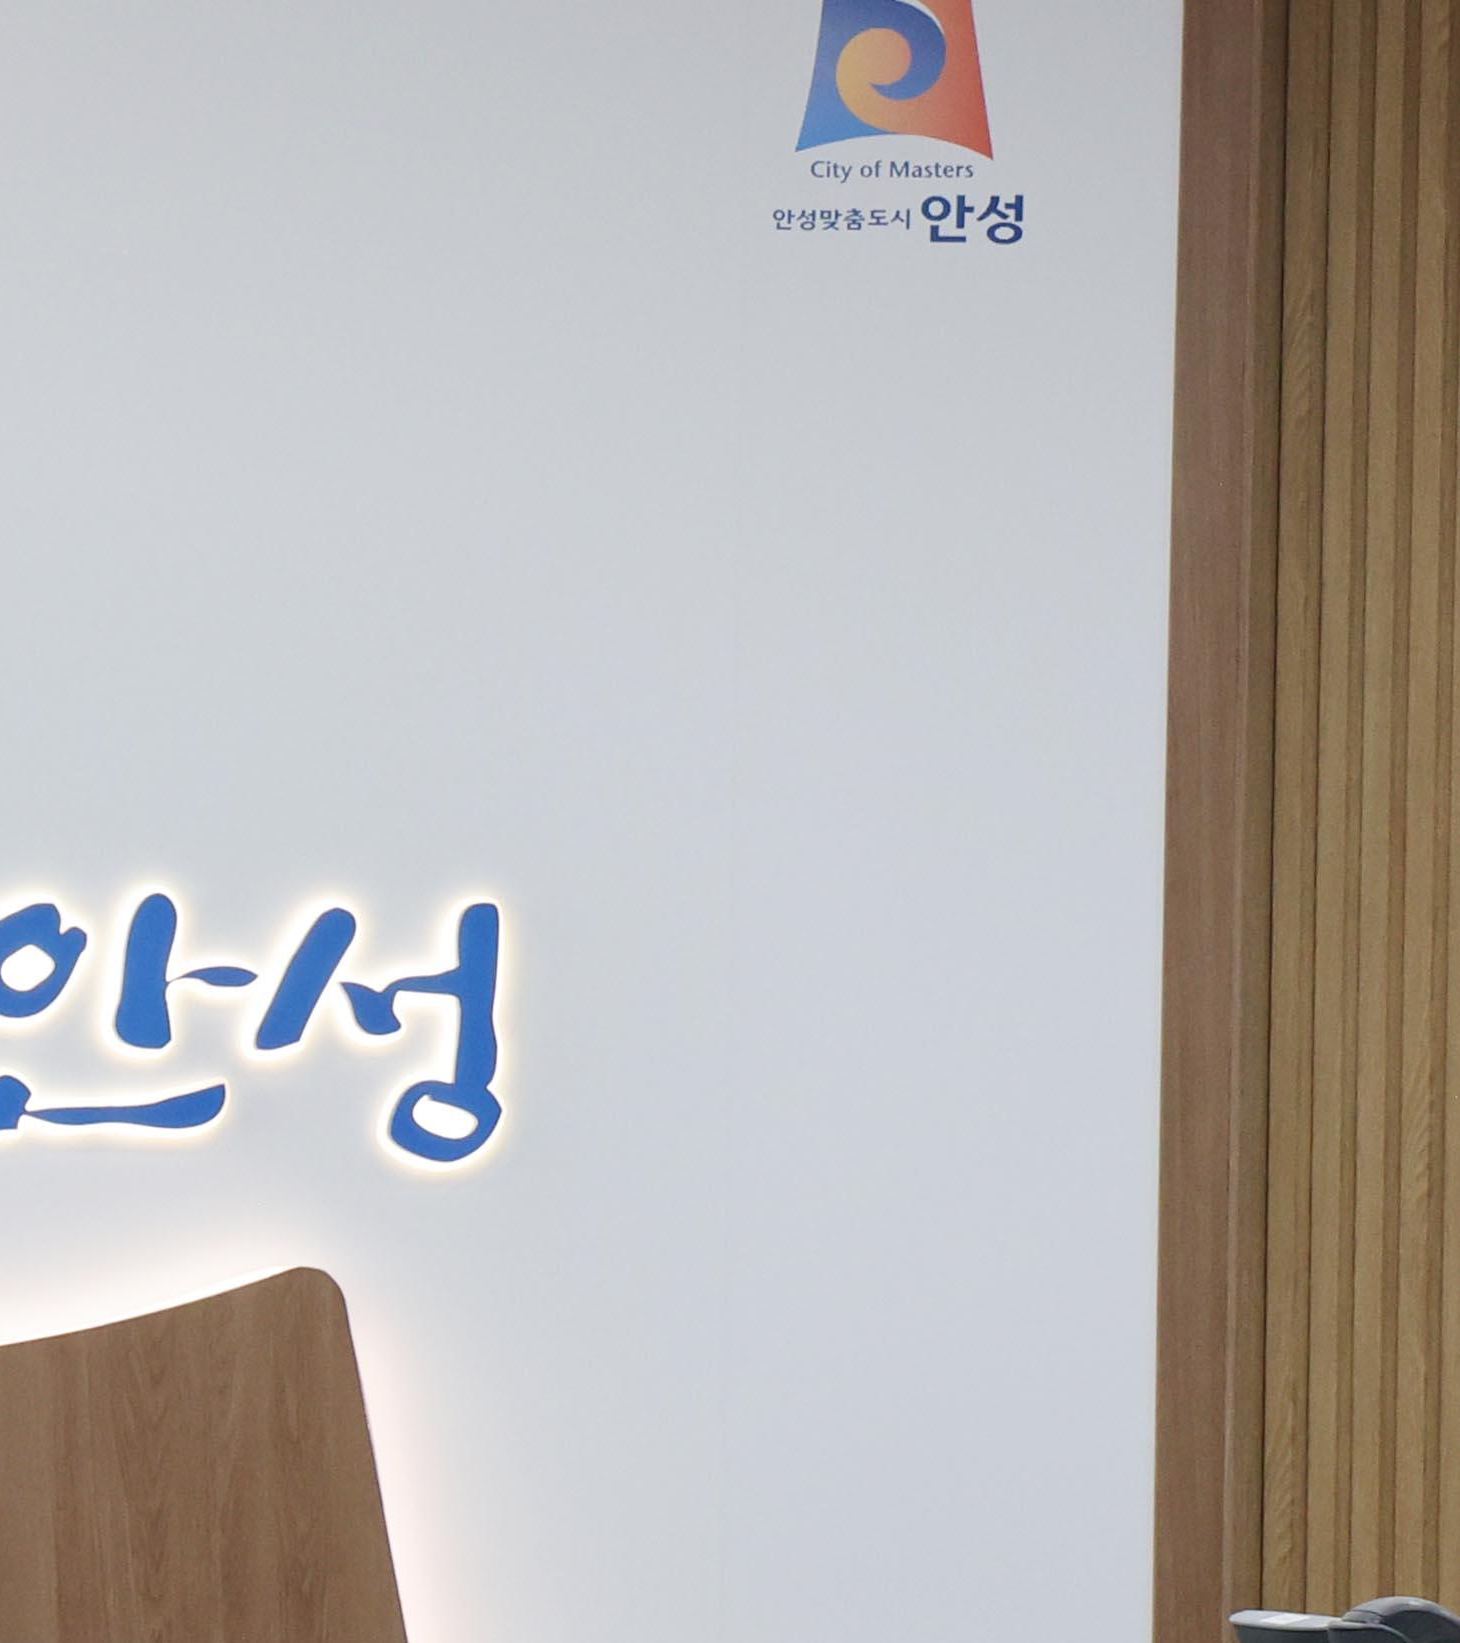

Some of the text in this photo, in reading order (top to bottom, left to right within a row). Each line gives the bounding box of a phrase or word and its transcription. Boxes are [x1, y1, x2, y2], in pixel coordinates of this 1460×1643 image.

[810, 160, 974, 183] City of Masters
[772, 194, 1025, 245] 안성맞춤도시 안성
